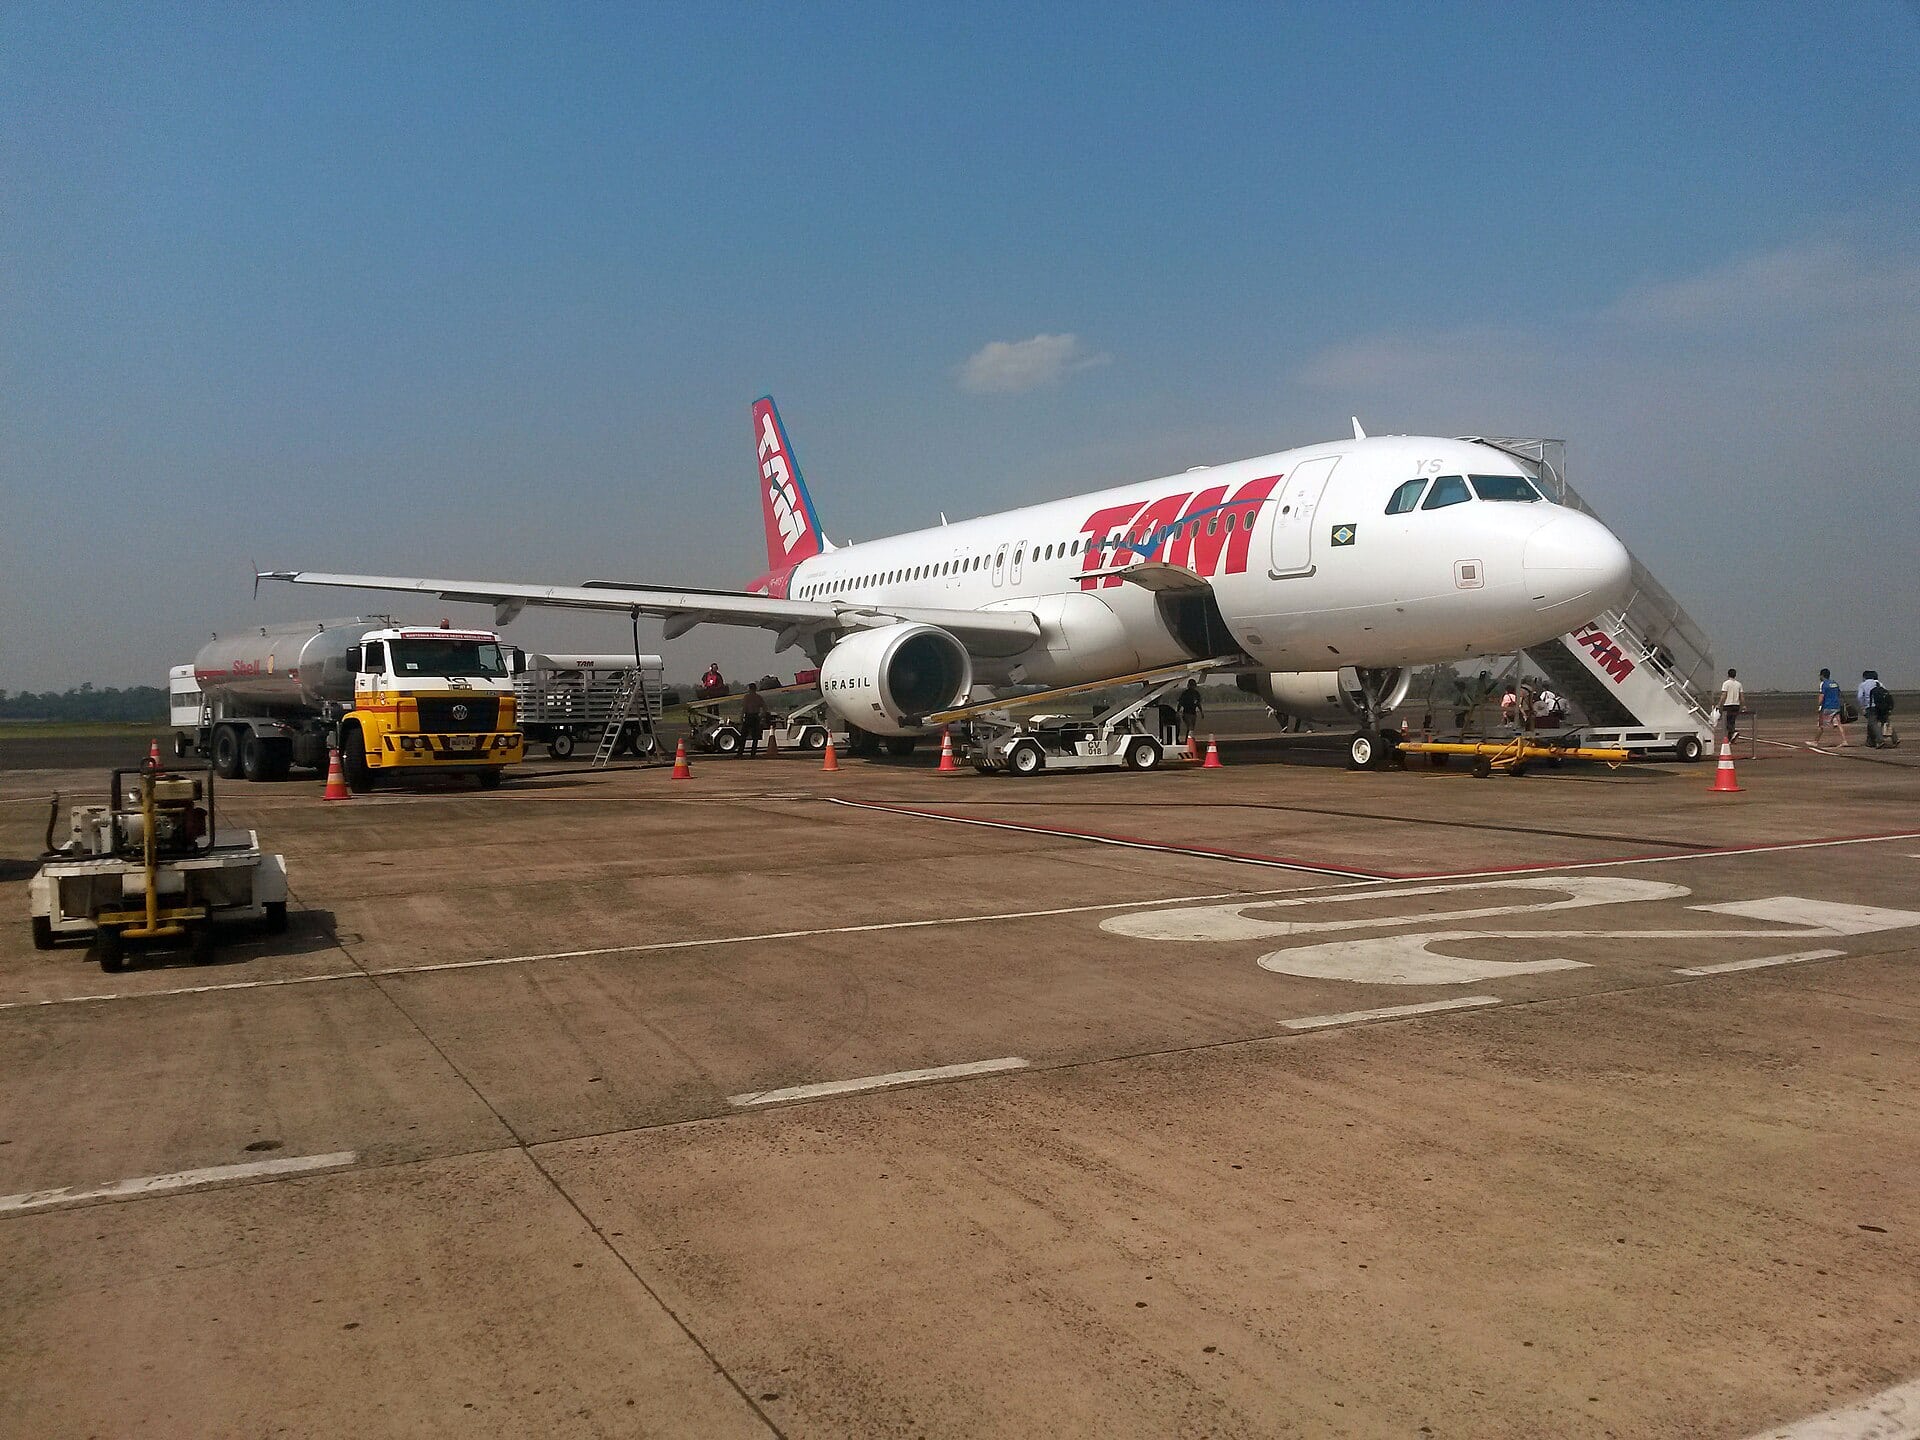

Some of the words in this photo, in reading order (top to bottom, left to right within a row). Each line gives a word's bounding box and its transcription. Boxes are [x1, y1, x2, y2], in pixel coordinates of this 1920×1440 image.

[1416, 459, 1443, 475] YS
[758, 413, 807, 555] TAM
[1080, 474, 1284, 591] TAM
[232, 660, 260, 676] Shell
[824, 677, 870, 691] BRASIL
[1087, 741, 1100, 749] CV
